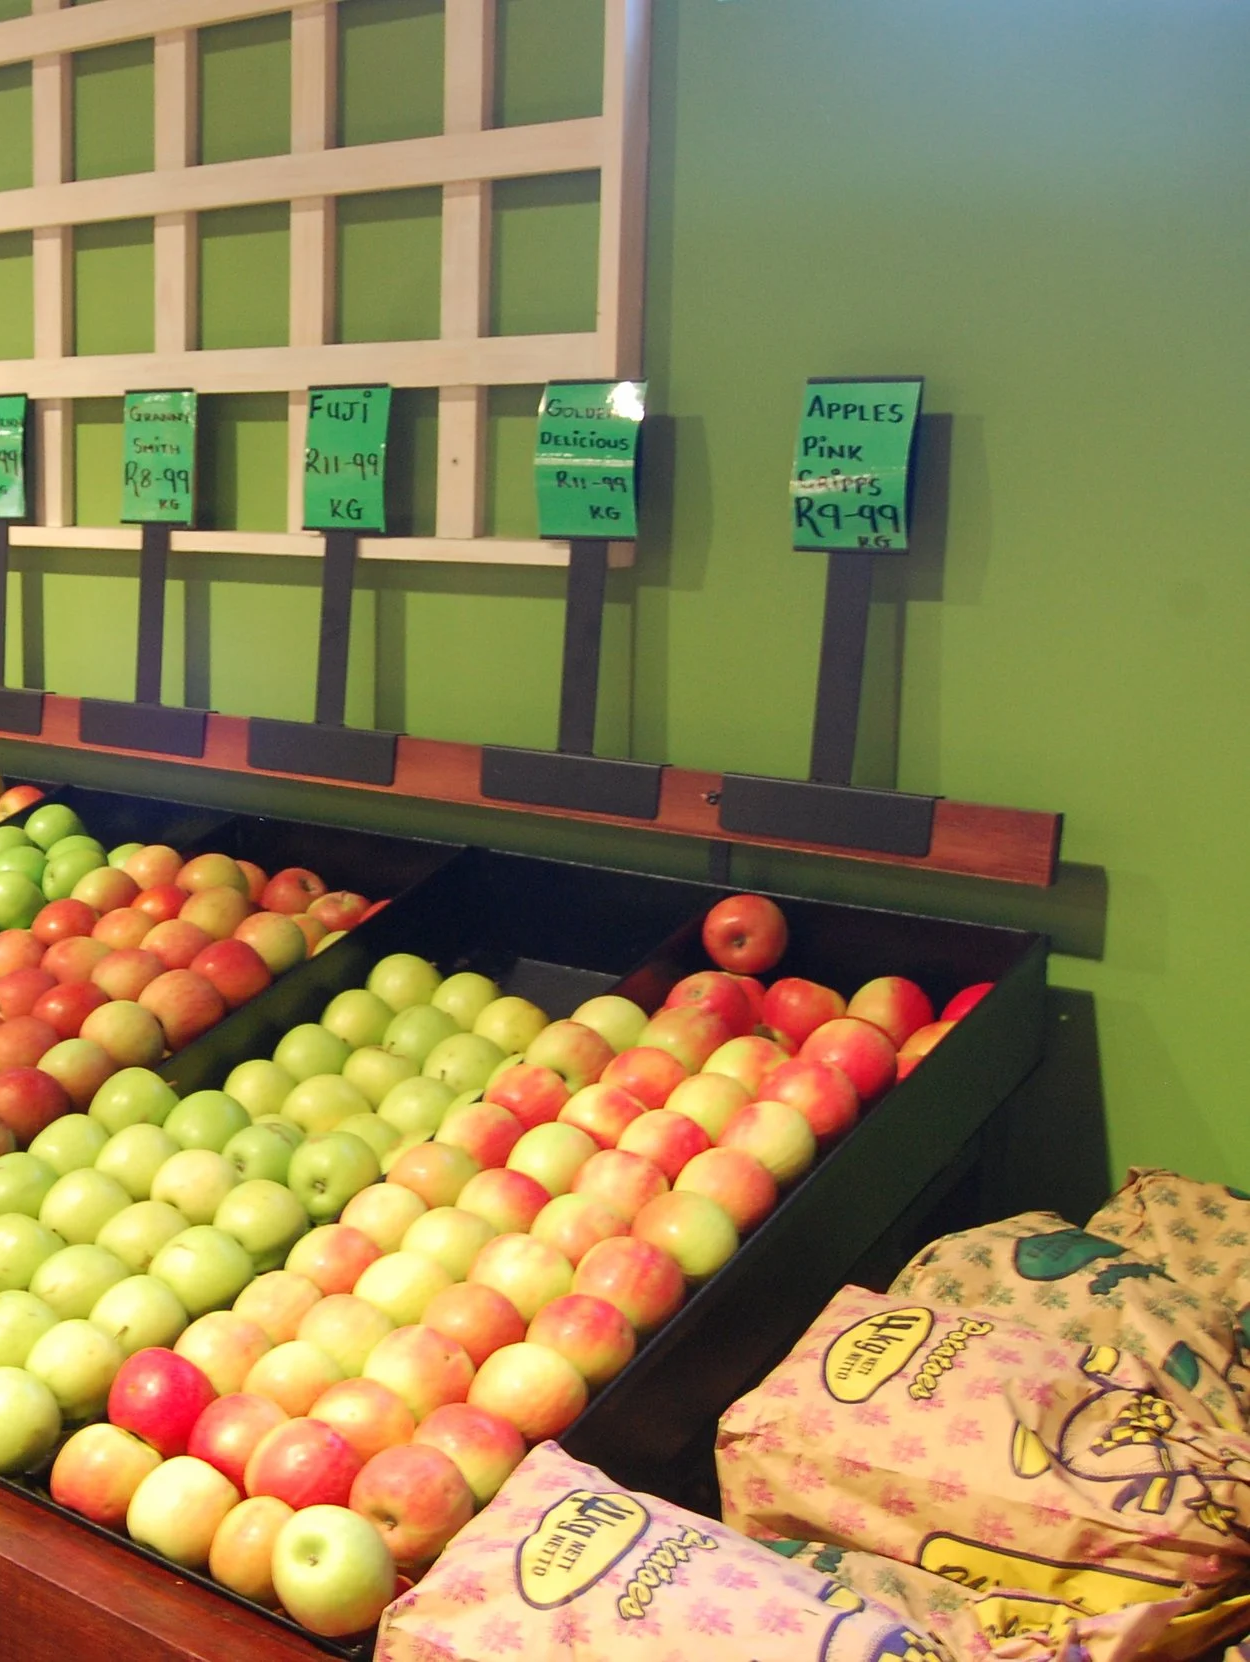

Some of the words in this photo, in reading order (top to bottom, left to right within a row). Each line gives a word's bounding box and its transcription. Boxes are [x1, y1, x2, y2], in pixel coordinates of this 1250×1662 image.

[806, 394, 904, 424] APPLES
[124, 460, 190, 498] R8-99
[304, 447, 379, 481] R11-99
[555, 470, 628, 493] R11-99
[158, 499, 180, 511] KG
[329, 498, 364, 520] KG
[589, 504, 621, 521] KG
[794, 495, 902, 538] R9-99
[908, 1316, 995, 1401] Potatoes
[532, 1533, 567, 1578] NETTO
[555, 1539, 588, 1573] NETT
[617, 1523, 720, 1622] Potatoes
